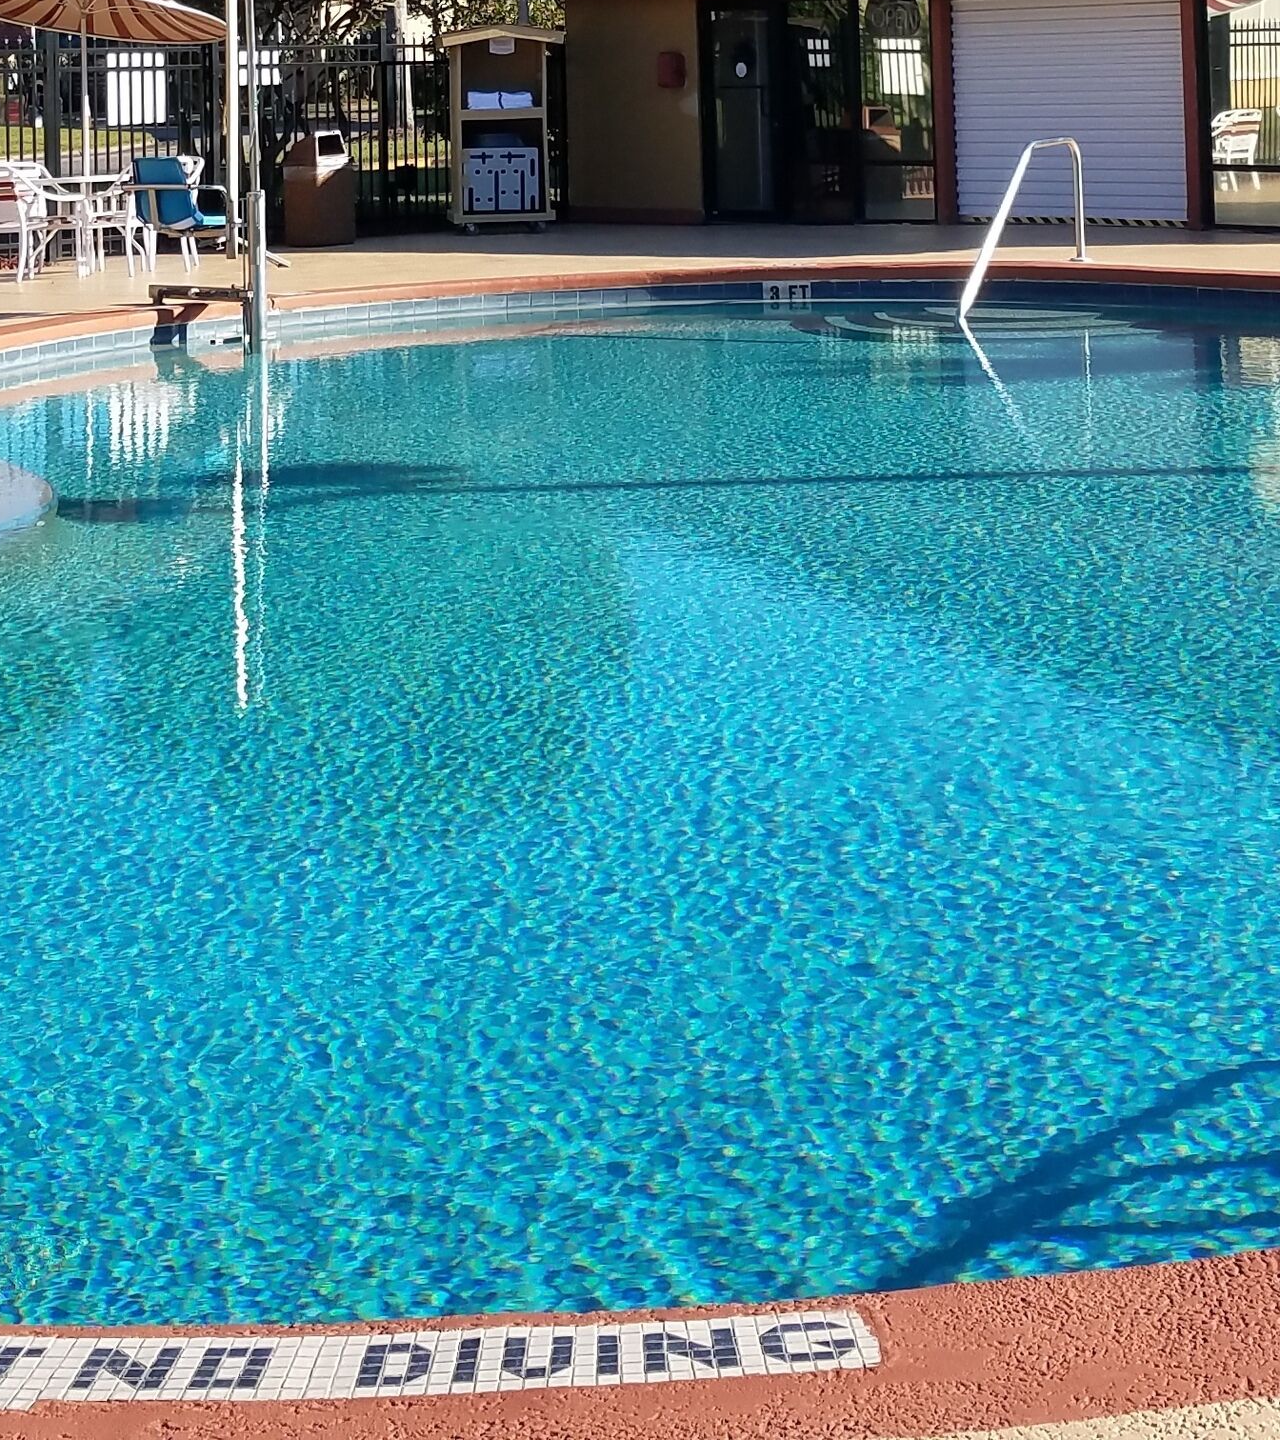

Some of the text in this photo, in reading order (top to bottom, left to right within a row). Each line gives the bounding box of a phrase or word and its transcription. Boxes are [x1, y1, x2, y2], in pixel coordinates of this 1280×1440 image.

[871, 6, 918, 32] OPEN
[769, 285, 809, 301] 3 FT
[70, 1347, 274, 1390] NO
[355, 1321, 858, 1388] DIVING
